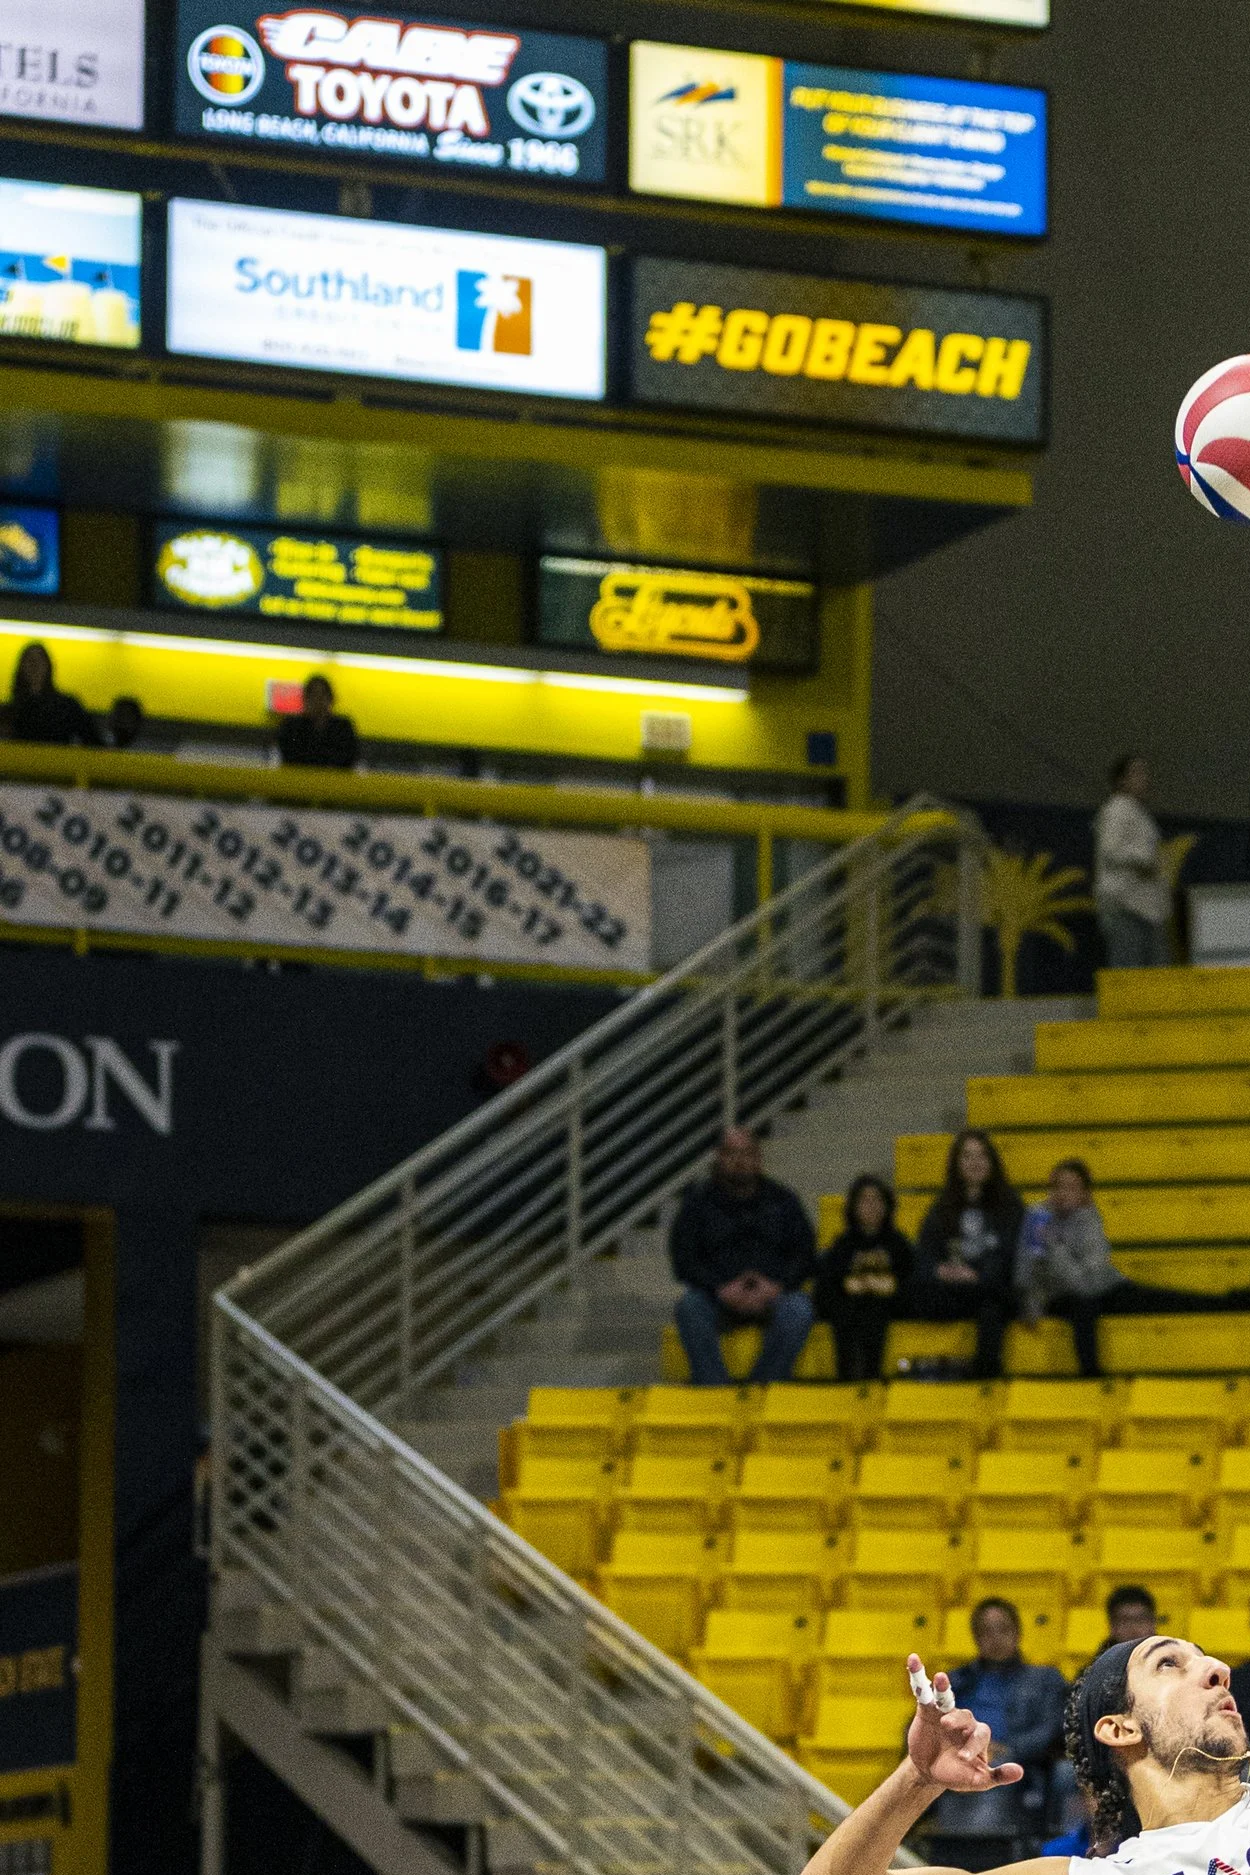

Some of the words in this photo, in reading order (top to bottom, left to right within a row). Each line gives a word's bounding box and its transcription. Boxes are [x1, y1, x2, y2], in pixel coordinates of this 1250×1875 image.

[257, 9, 521, 85] CABE
[202, 108, 254, 132] LONG
[321, 121, 431, 157] CALIFORNIA
[286, 63, 491, 137] TOYOTA
[433, 129, 503, 166] Since
[508, 138, 580, 176] 1966
[655, 113, 743, 160] SRK
[234, 256, 444, 313] Southland
[645, 301, 1032, 400] #GOBEACH
[35, 795, 182, 919] 2010-11
[116, 801, 256, 922] 2011-12
[190, 808, 334, 930] 2012-13
[271, 818, 412, 935] 2013-14
[342, 821, 486, 941] 2014-15
[420, 824, 564, 946] 2016-17
[495, 832, 628, 949] 2021-22
[0, 1031, 182, 1136] ON
